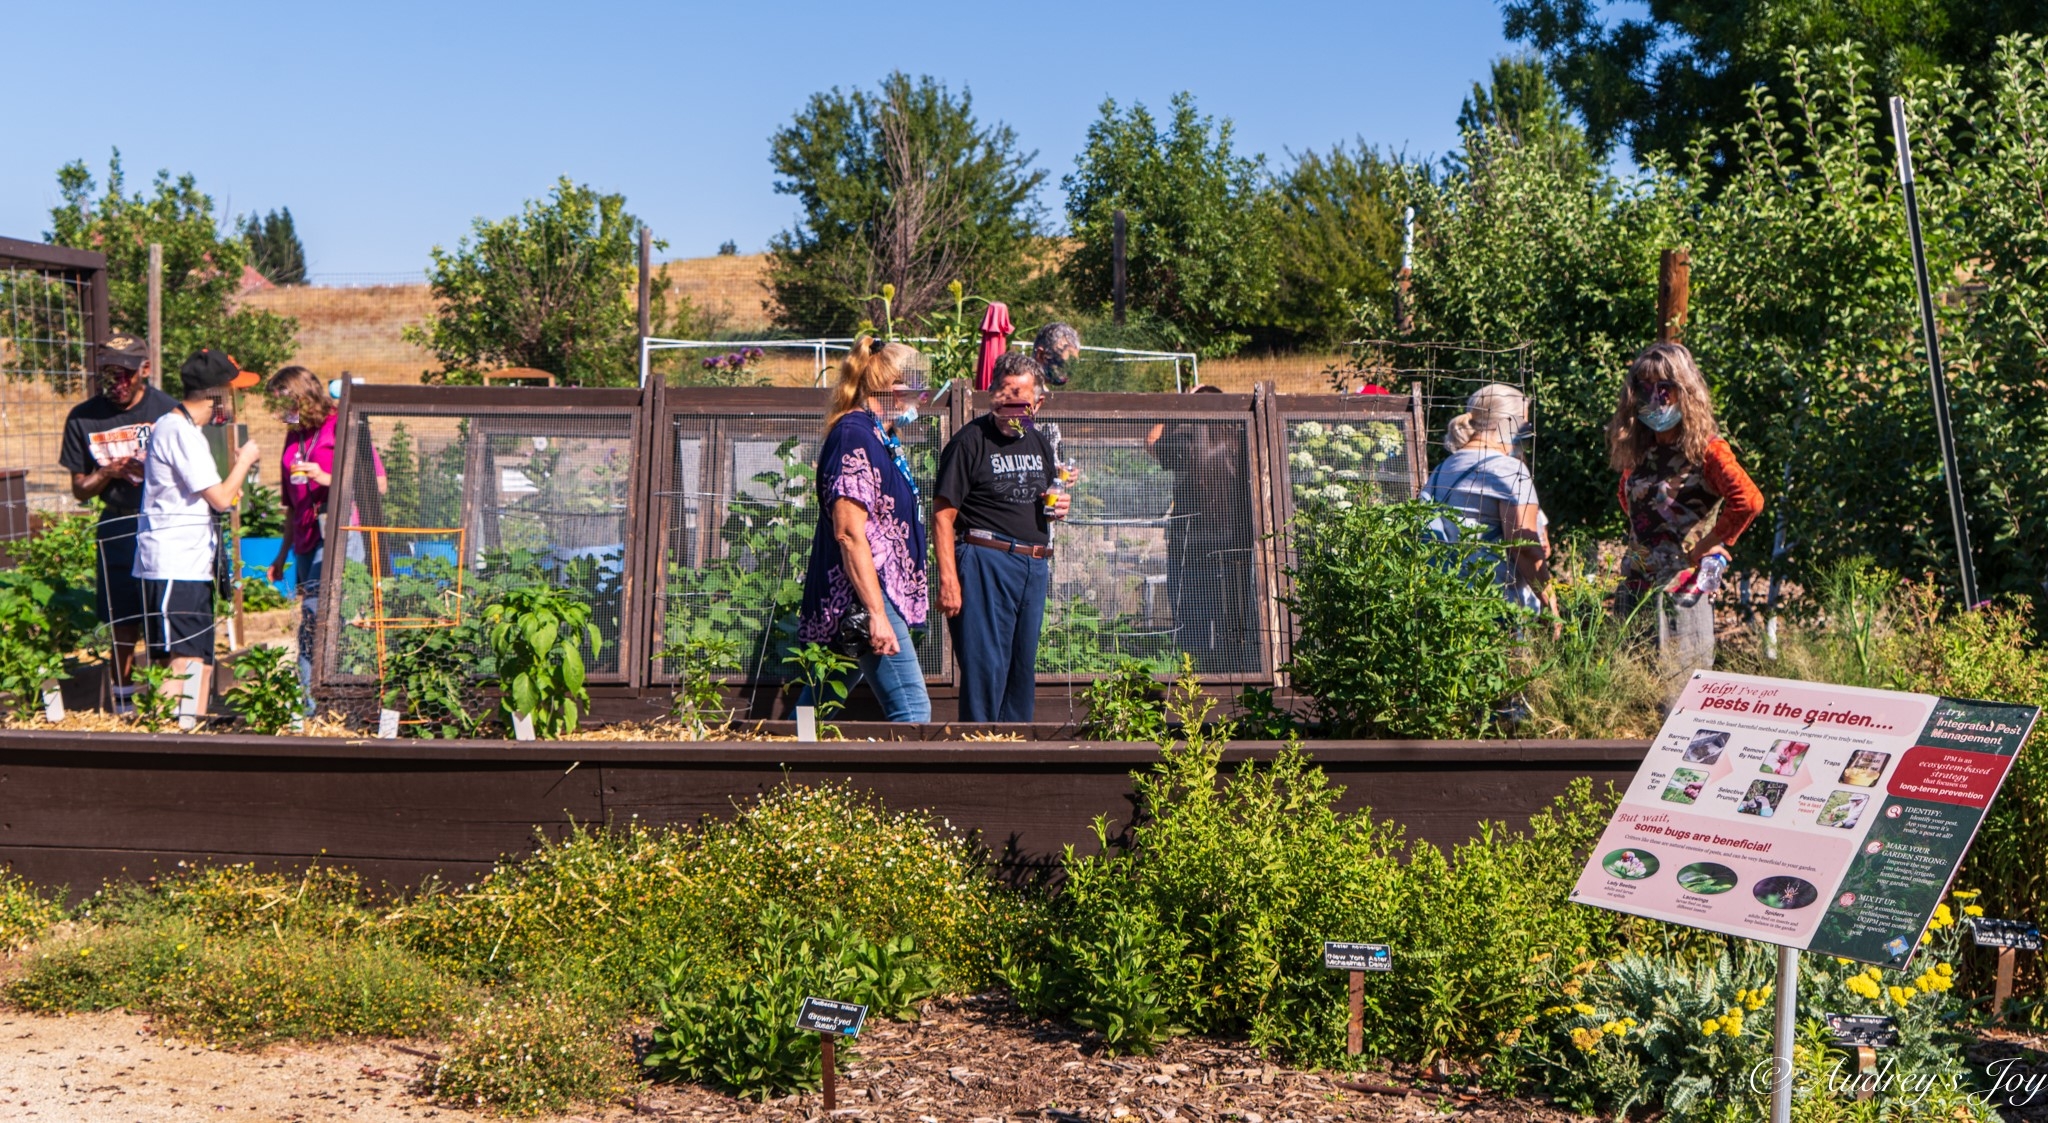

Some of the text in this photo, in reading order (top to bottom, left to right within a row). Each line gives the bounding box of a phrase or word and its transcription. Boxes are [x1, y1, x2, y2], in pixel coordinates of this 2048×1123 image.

[992, 454, 1043, 473] SAN LUCAS
[1698, 683, 1779, 698] Help! I've got
[1700, 697, 1894, 730] pests in the garden....
[1937, 718, 2022, 735] Integrated Pest
[1668, 733, 1690, 741] Barriers
[1931, 728, 2002, 745] Management
[1661, 746, 1683, 754] Screens
[1743, 746, 1765, 754] Remove
[1918, 761, 1994, 775] ecosystem-based
[1930, 770, 1969, 782] strategy
[1937, 780, 1958, 788] focuses
[1718, 787, 1744, 796] Selective
[1900, 782, 1984, 800] long-term prevention
[1716, 794, 1739, 802] Pruning
[1800, 794, 1826, 803] Pesticide
[1905, 806, 1942, 817] IDENTIFY:
[1618, 813, 1669, 823] But wait,
[1910, 815, 1931, 823] Identify
[1634, 823, 1772, 853] some bugs are beneficial!
[1886, 842, 1930, 854] MAKE YOUR
[1882, 850, 1947, 866] GARDEN STRONG:
[1683, 894, 1708, 903] Lacewings
[1859, 894, 1874, 902] MIX
[1884, 898, 1896, 906] UP:
[1879, 907, 1913, 917] combination
[808, 1012, 851, 1026] (Brown-Eyed
[814, 1021, 836, 1030] Susan)
